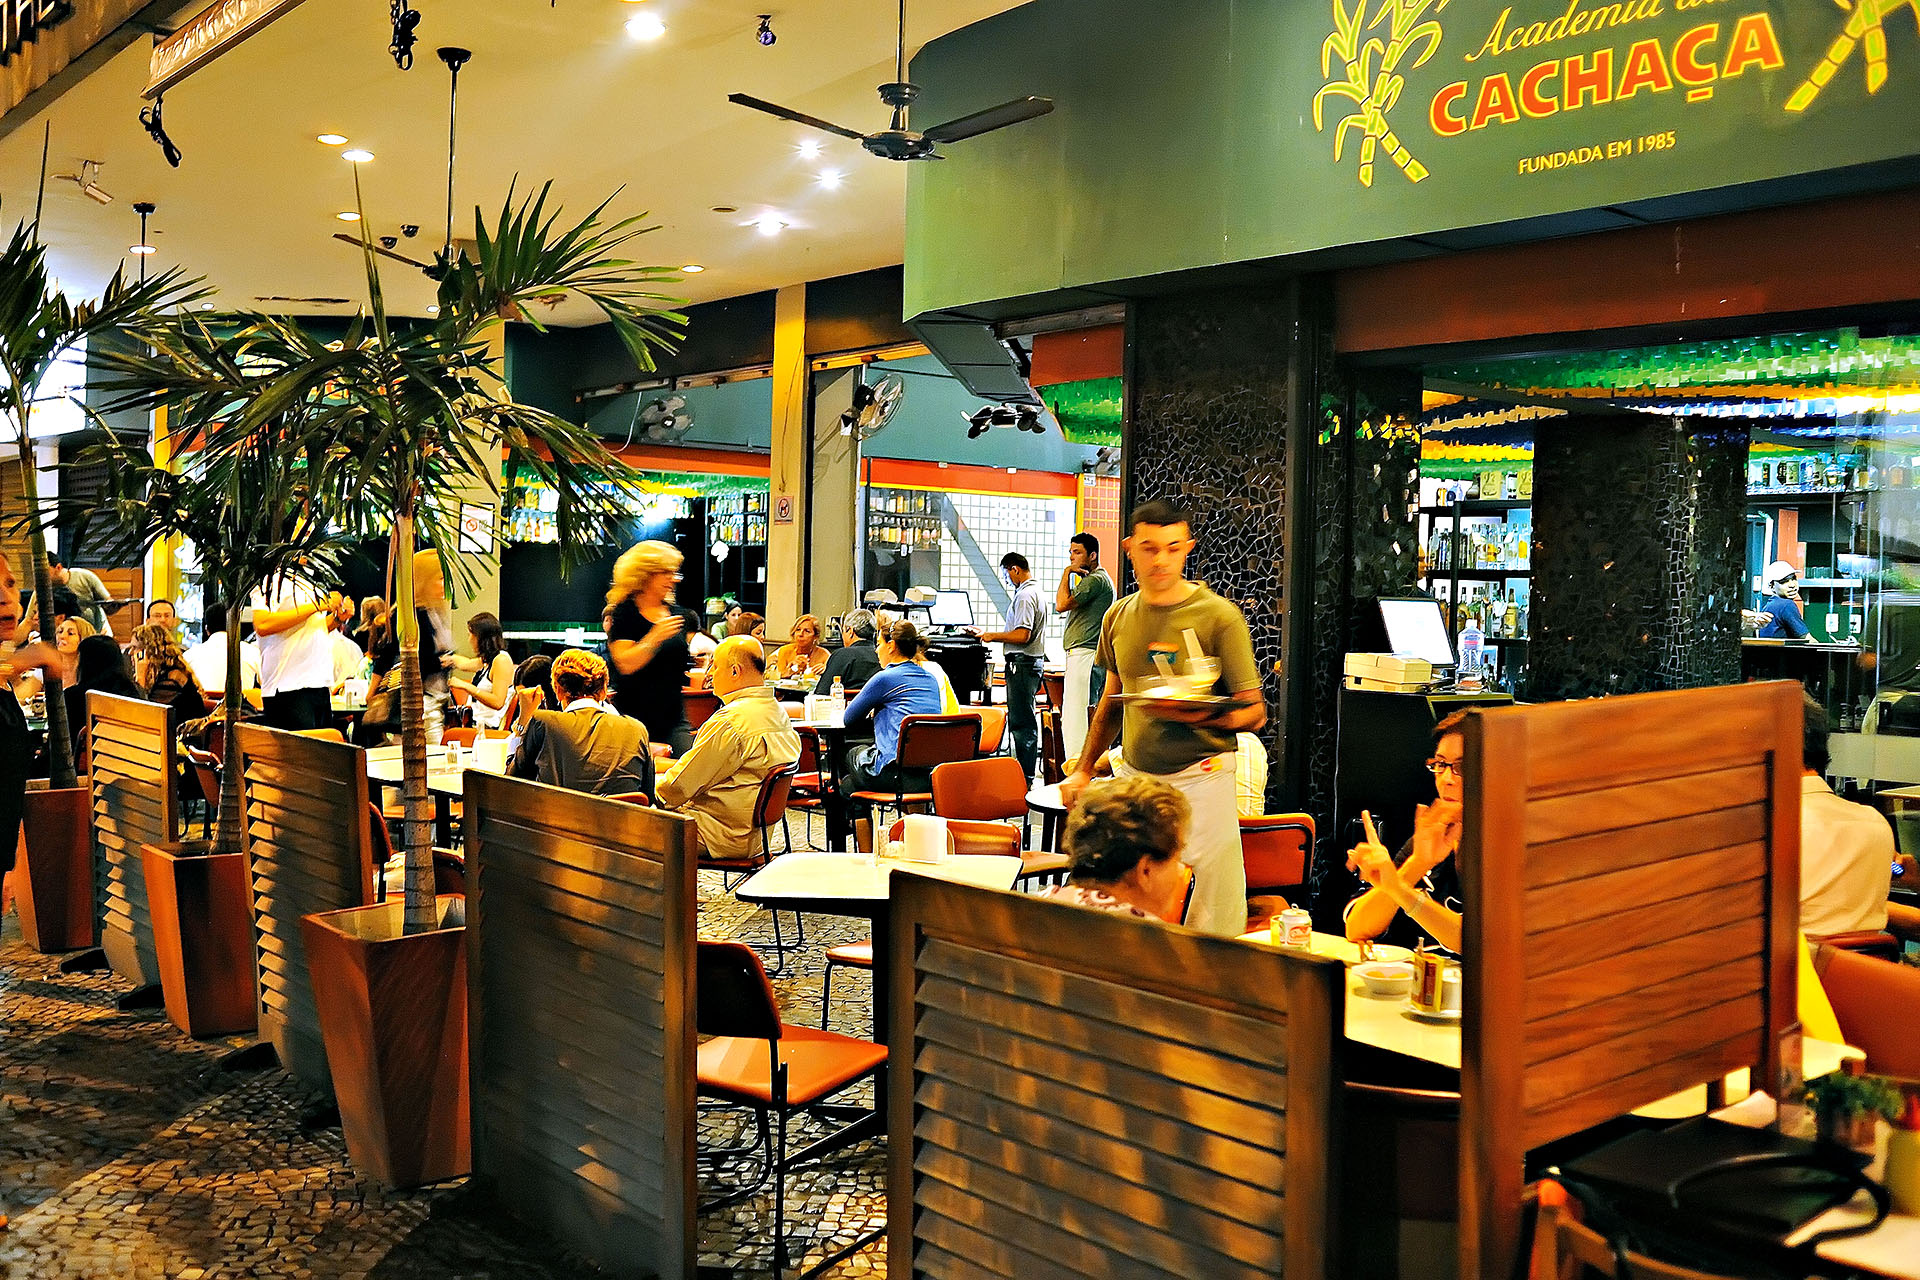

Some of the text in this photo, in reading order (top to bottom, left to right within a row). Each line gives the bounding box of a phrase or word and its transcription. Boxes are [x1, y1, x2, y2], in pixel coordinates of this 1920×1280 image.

[1464, 0, 1665, 62] Academia
[1429, 12, 1785, 137] CACHAÇA
[1518, 131, 1677, 175] FUNDADA EM 1985
